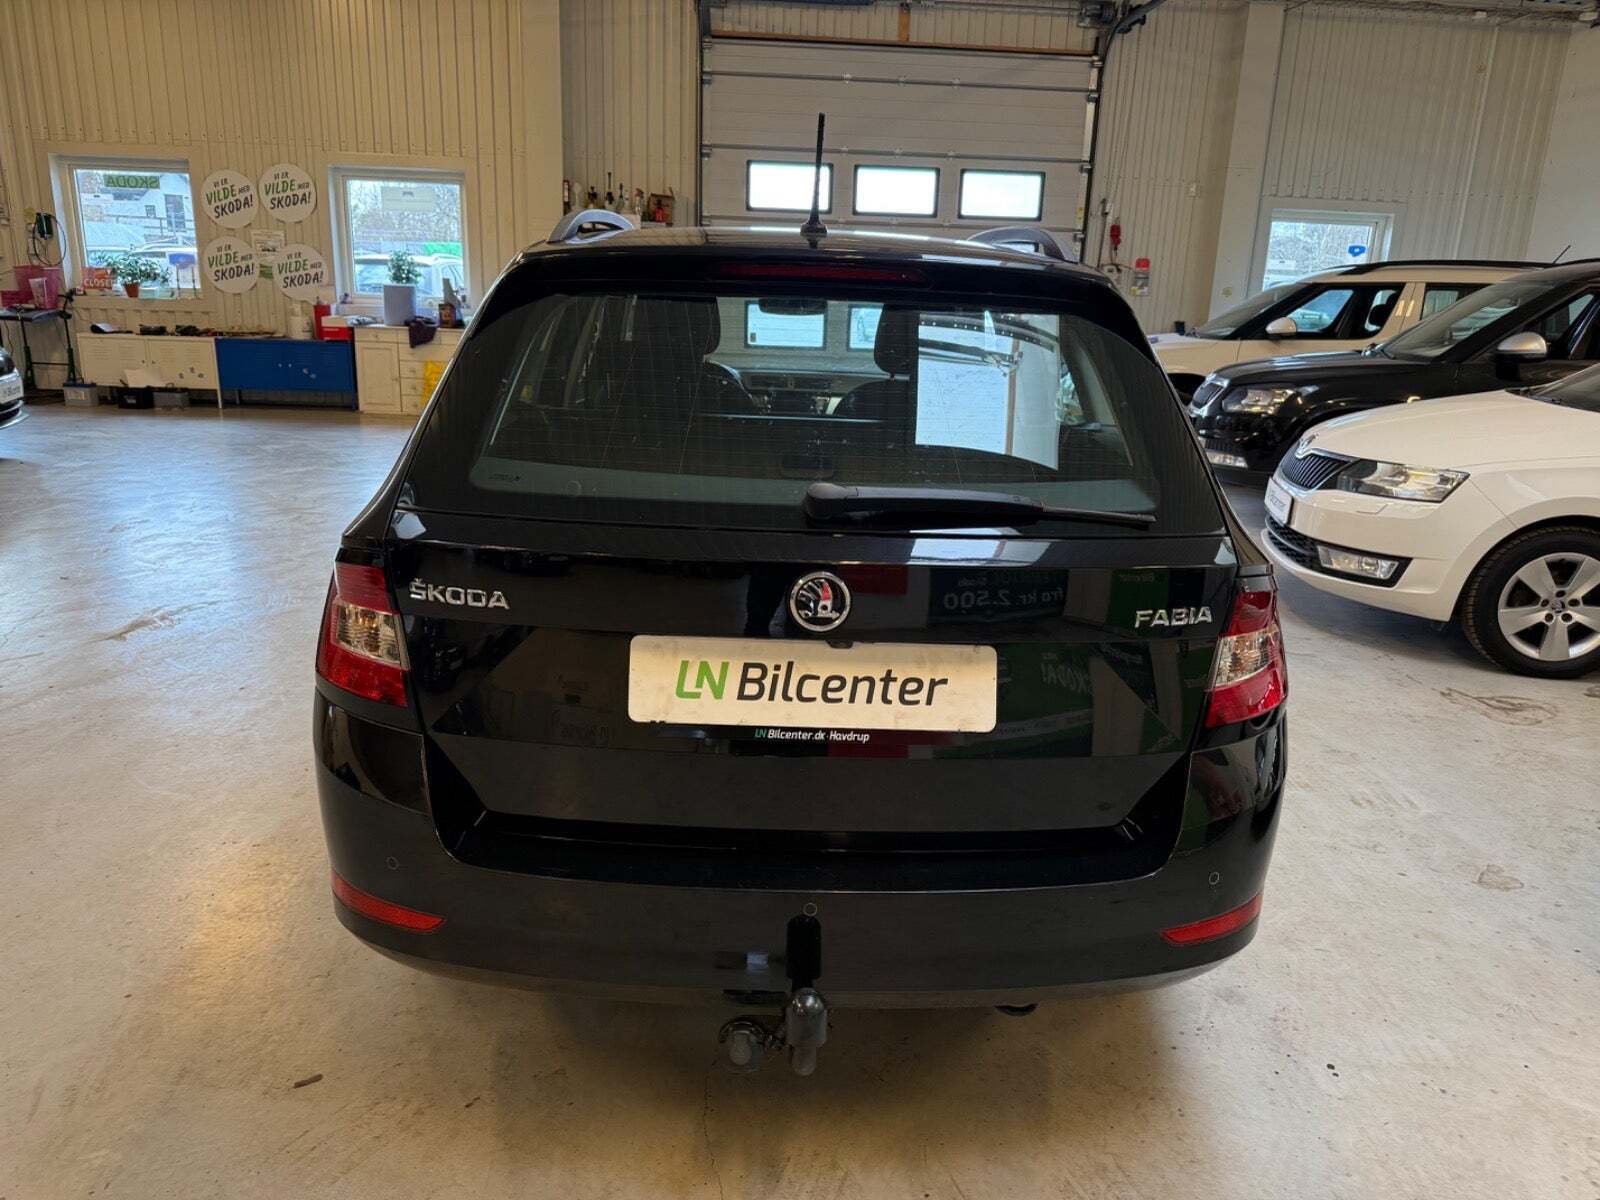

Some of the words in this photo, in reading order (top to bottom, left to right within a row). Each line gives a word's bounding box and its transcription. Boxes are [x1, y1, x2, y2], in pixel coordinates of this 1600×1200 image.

[220, 177, 229, 186] ER
[280, 171, 289, 179] ER
[206, 184, 237, 206] VILDE
[264, 179, 296, 196] VILDE
[214, 194, 254, 219] SKODA!
[270, 192, 312, 210] SKODA!
[207, 251, 239, 269] VILDE
[277, 258, 309, 275] VILDE
[214, 263, 255, 282] SKODA!
[282, 271, 324, 289] SKODA!
[409, 577, 510, 610] ŠKODA
[1135, 606, 1213, 628] FABIA
[675, 660, 729, 700] LN
[736, 661, 949, 706] Bilcenter
[754, 728, 767, 738] LN
[767, 729, 826, 740] Bilcenter.dk
[829, 730, 870, 744] Havdrup
